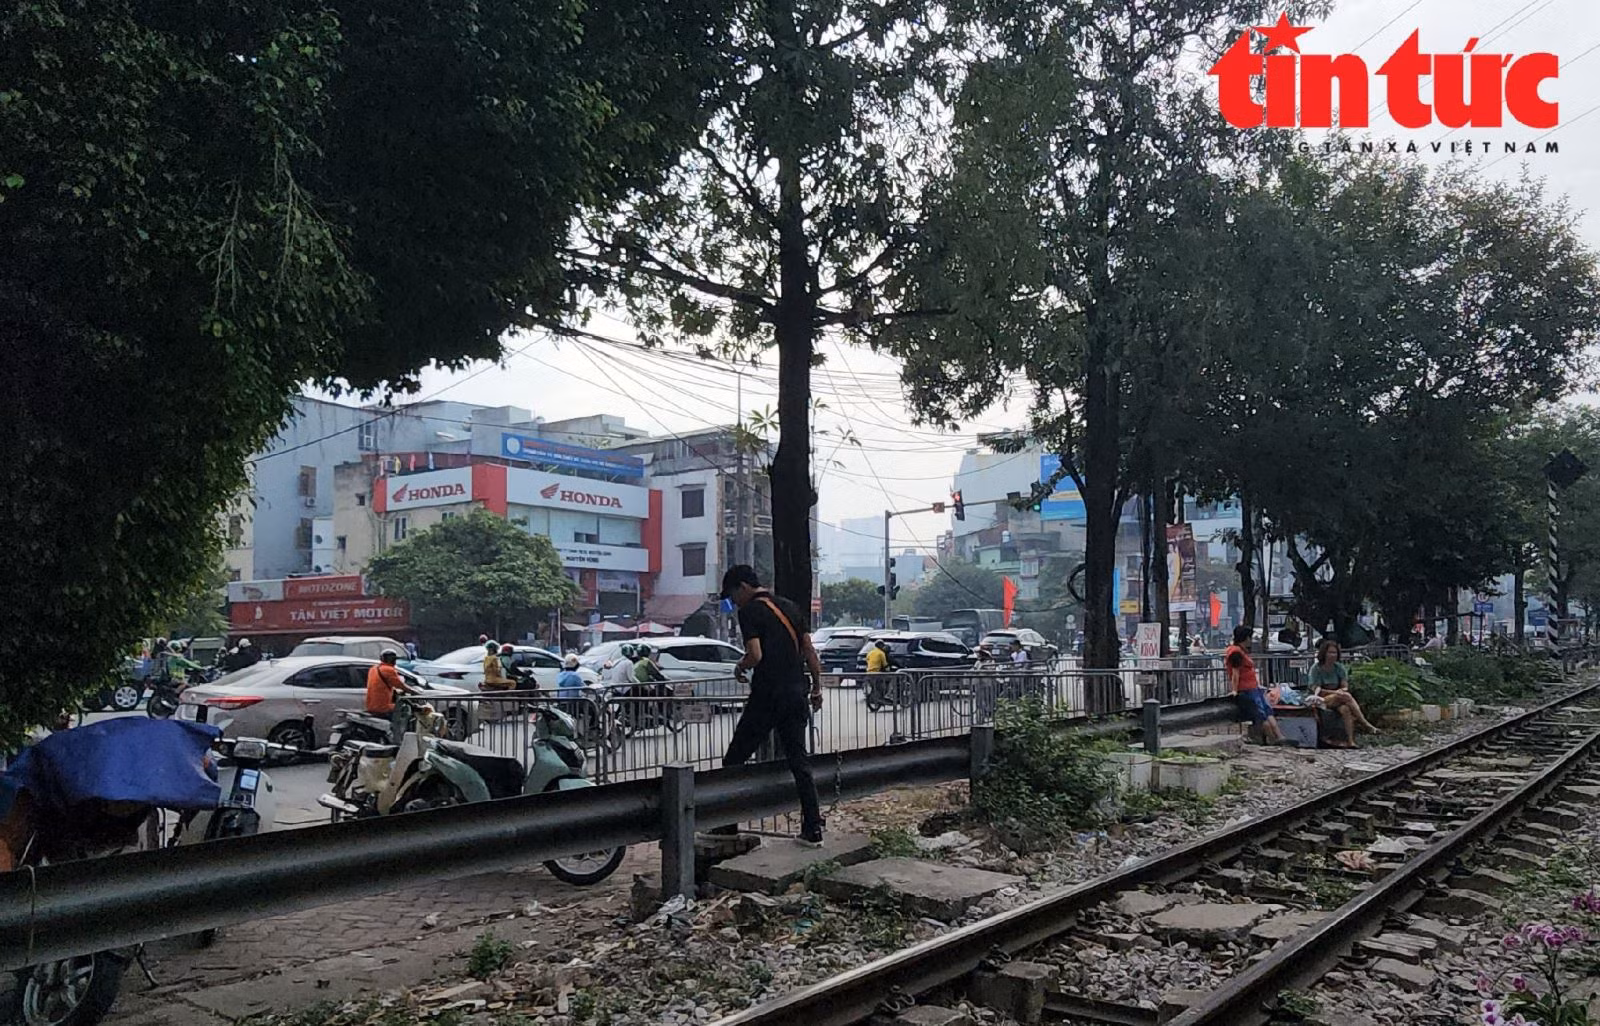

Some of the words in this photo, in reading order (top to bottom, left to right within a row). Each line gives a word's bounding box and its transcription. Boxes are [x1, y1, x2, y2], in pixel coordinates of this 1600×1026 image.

[408, 483, 466, 501] HONDA
[559, 489, 623, 509] HONDA
[299, 582, 358, 594] MOTOZONE
[290, 608, 315, 622] TÂN
[354, 607, 404, 619] MOTOR
